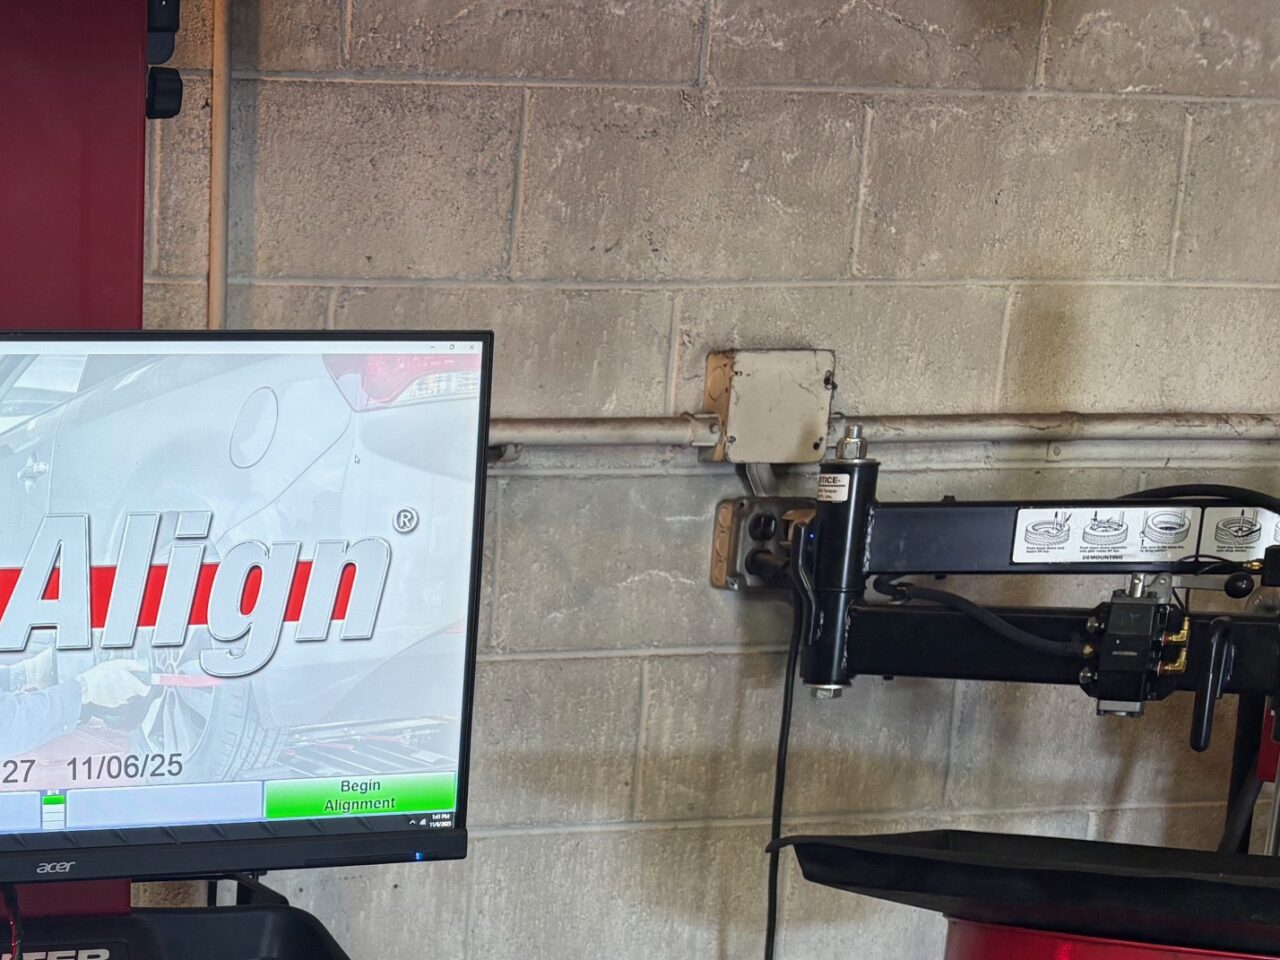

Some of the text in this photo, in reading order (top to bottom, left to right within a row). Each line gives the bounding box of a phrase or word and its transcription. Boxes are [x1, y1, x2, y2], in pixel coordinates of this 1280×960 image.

[66, 753, 184, 781] 11/06/25
[340, 779, 381, 794] Begin
[323, 796, 396, 814] Alignment
[36, 861, 76, 874] acer
